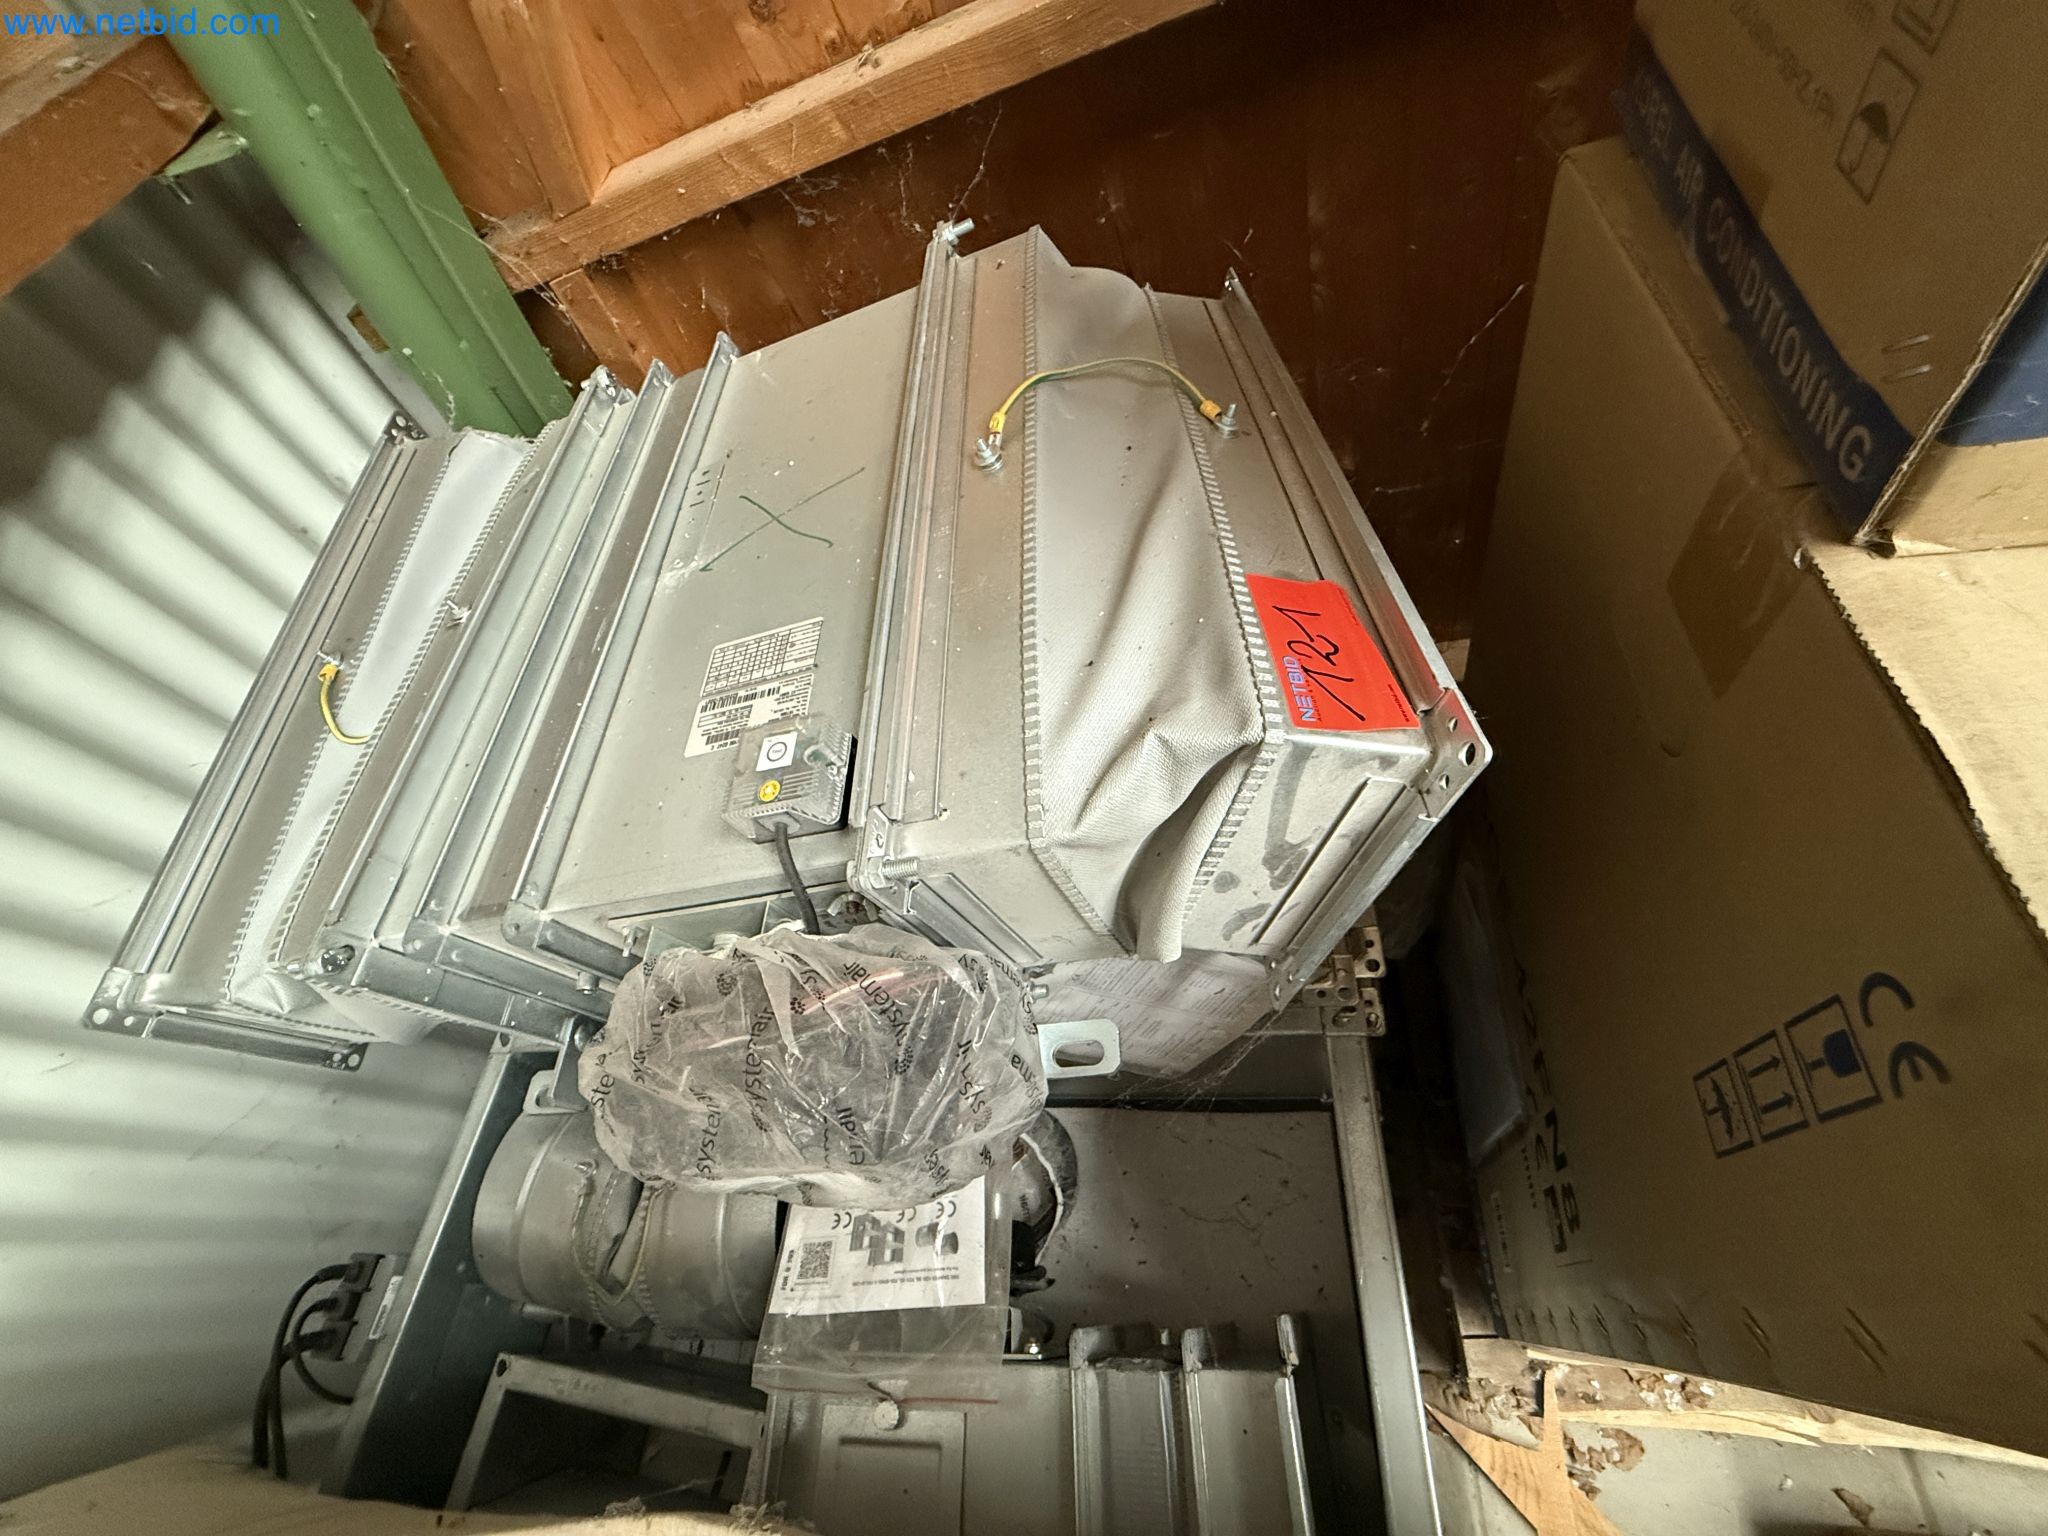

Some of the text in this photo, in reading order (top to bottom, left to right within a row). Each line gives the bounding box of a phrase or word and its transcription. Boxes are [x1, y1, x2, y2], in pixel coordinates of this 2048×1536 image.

[1706, 196, 1876, 484] CONDITIONING
[1272, 604, 1367, 722] 121
[1283, 655, 1317, 722] NETBID
